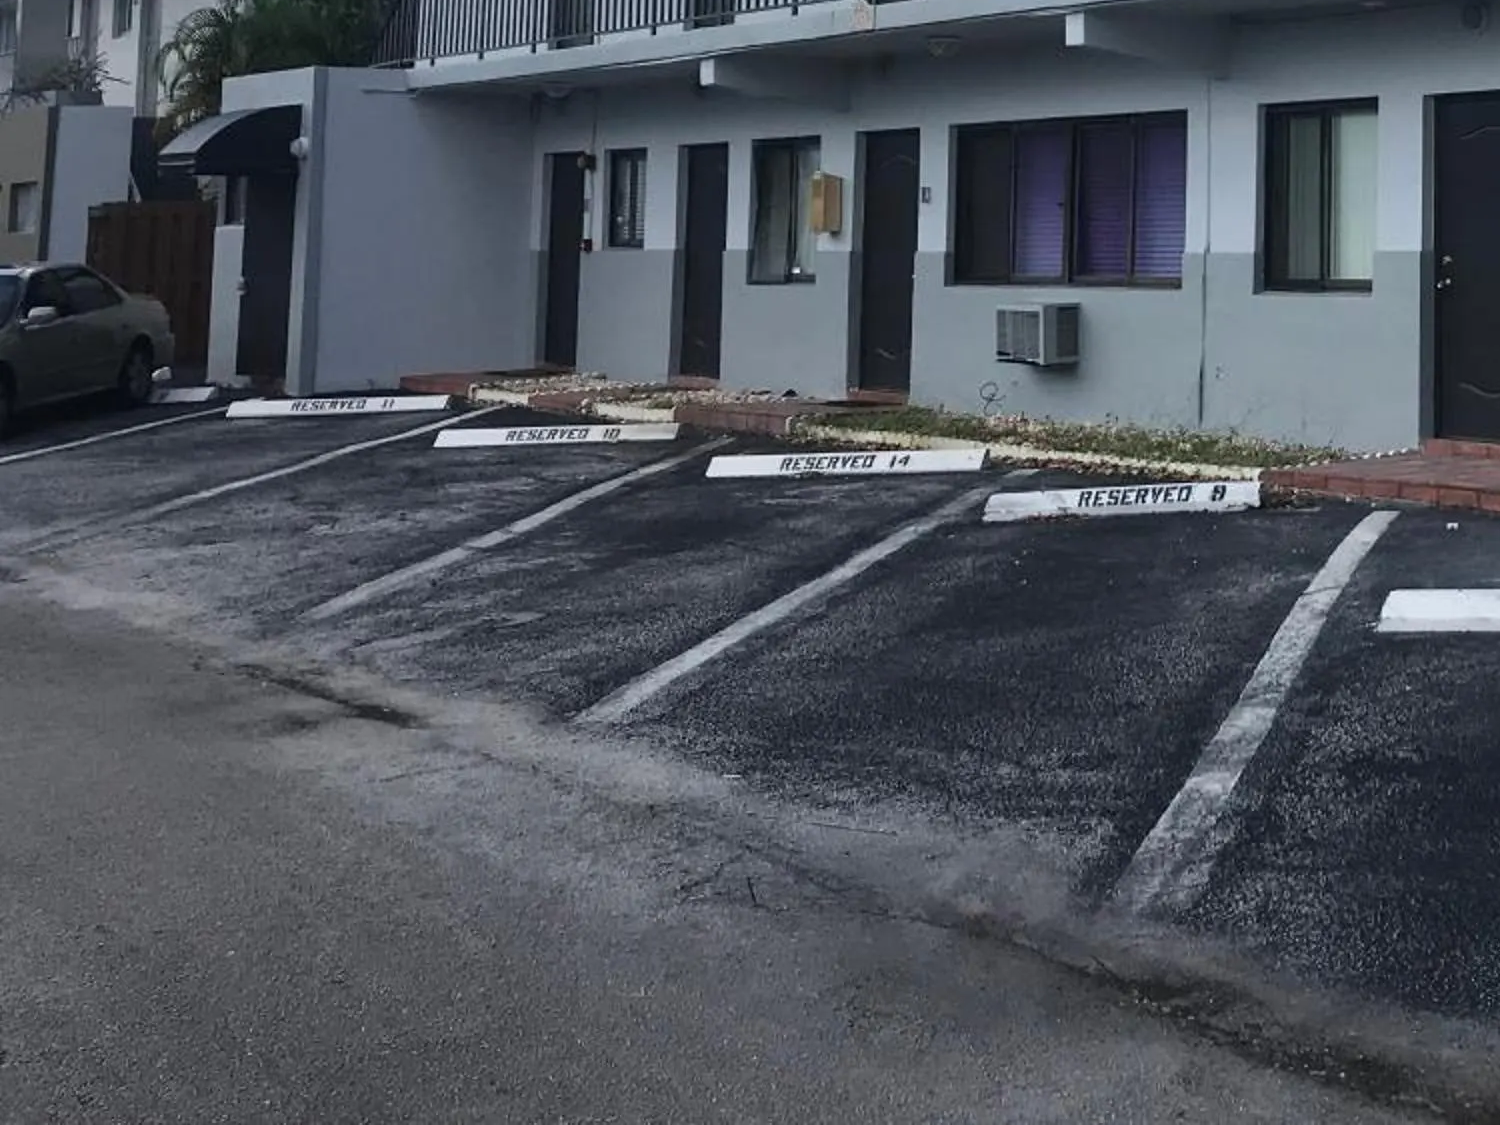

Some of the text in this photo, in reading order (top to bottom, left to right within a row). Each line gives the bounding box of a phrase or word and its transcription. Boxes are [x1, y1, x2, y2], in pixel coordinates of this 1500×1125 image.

[506, 428, 590, 442] RESERVED
[780, 454, 911, 471] RESERVED 14
[1078, 485, 1193, 508] RESERVED
